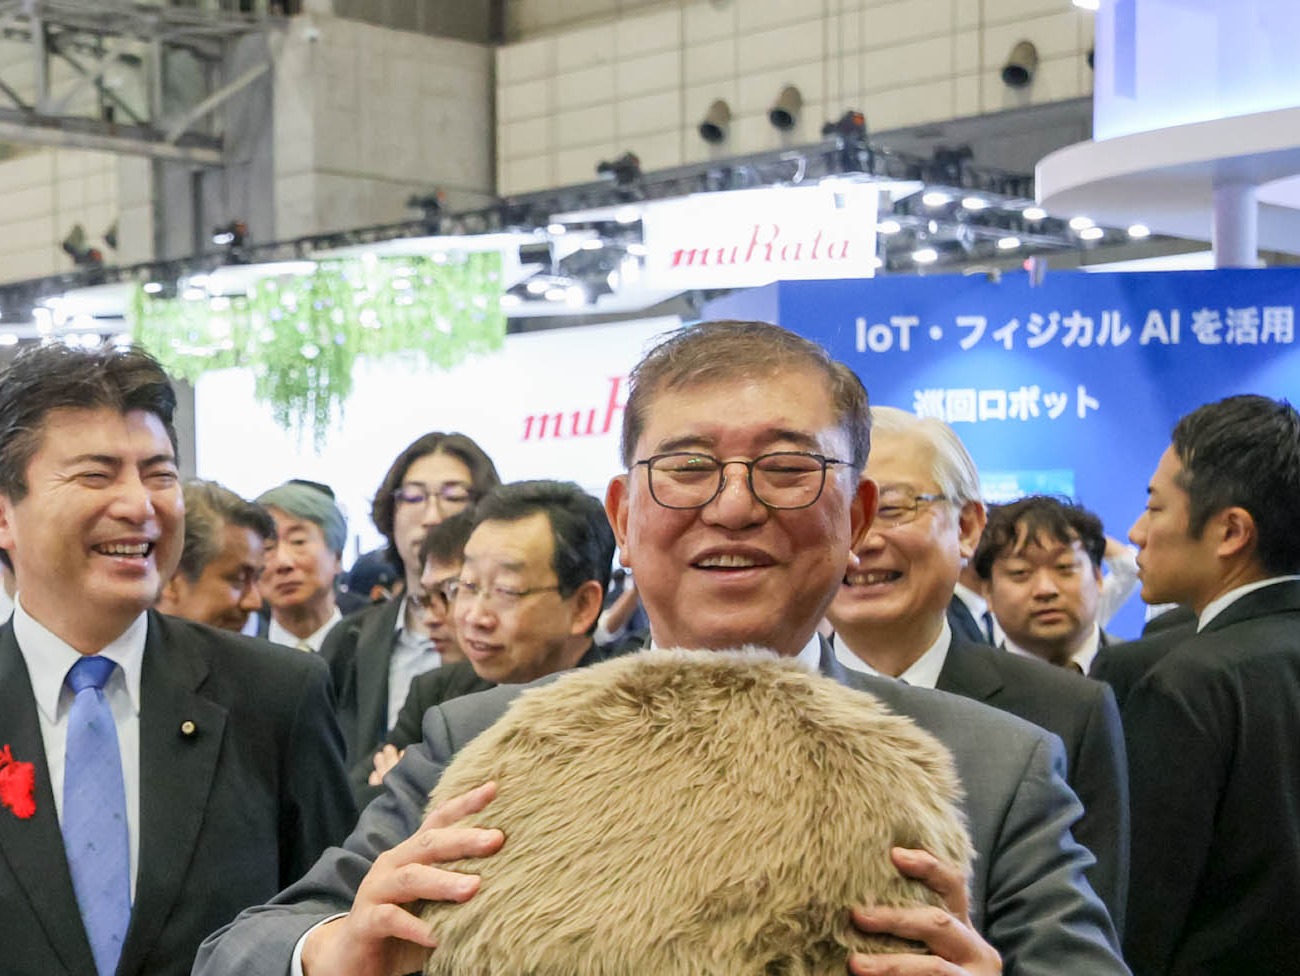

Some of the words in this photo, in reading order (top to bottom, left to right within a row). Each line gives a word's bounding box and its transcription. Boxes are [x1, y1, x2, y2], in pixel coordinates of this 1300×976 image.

[1138, 312, 1181, 346] AI
[1190, 306, 1296, 346] を活用
[912, 384, 1100, 424] 巡回ロボット
